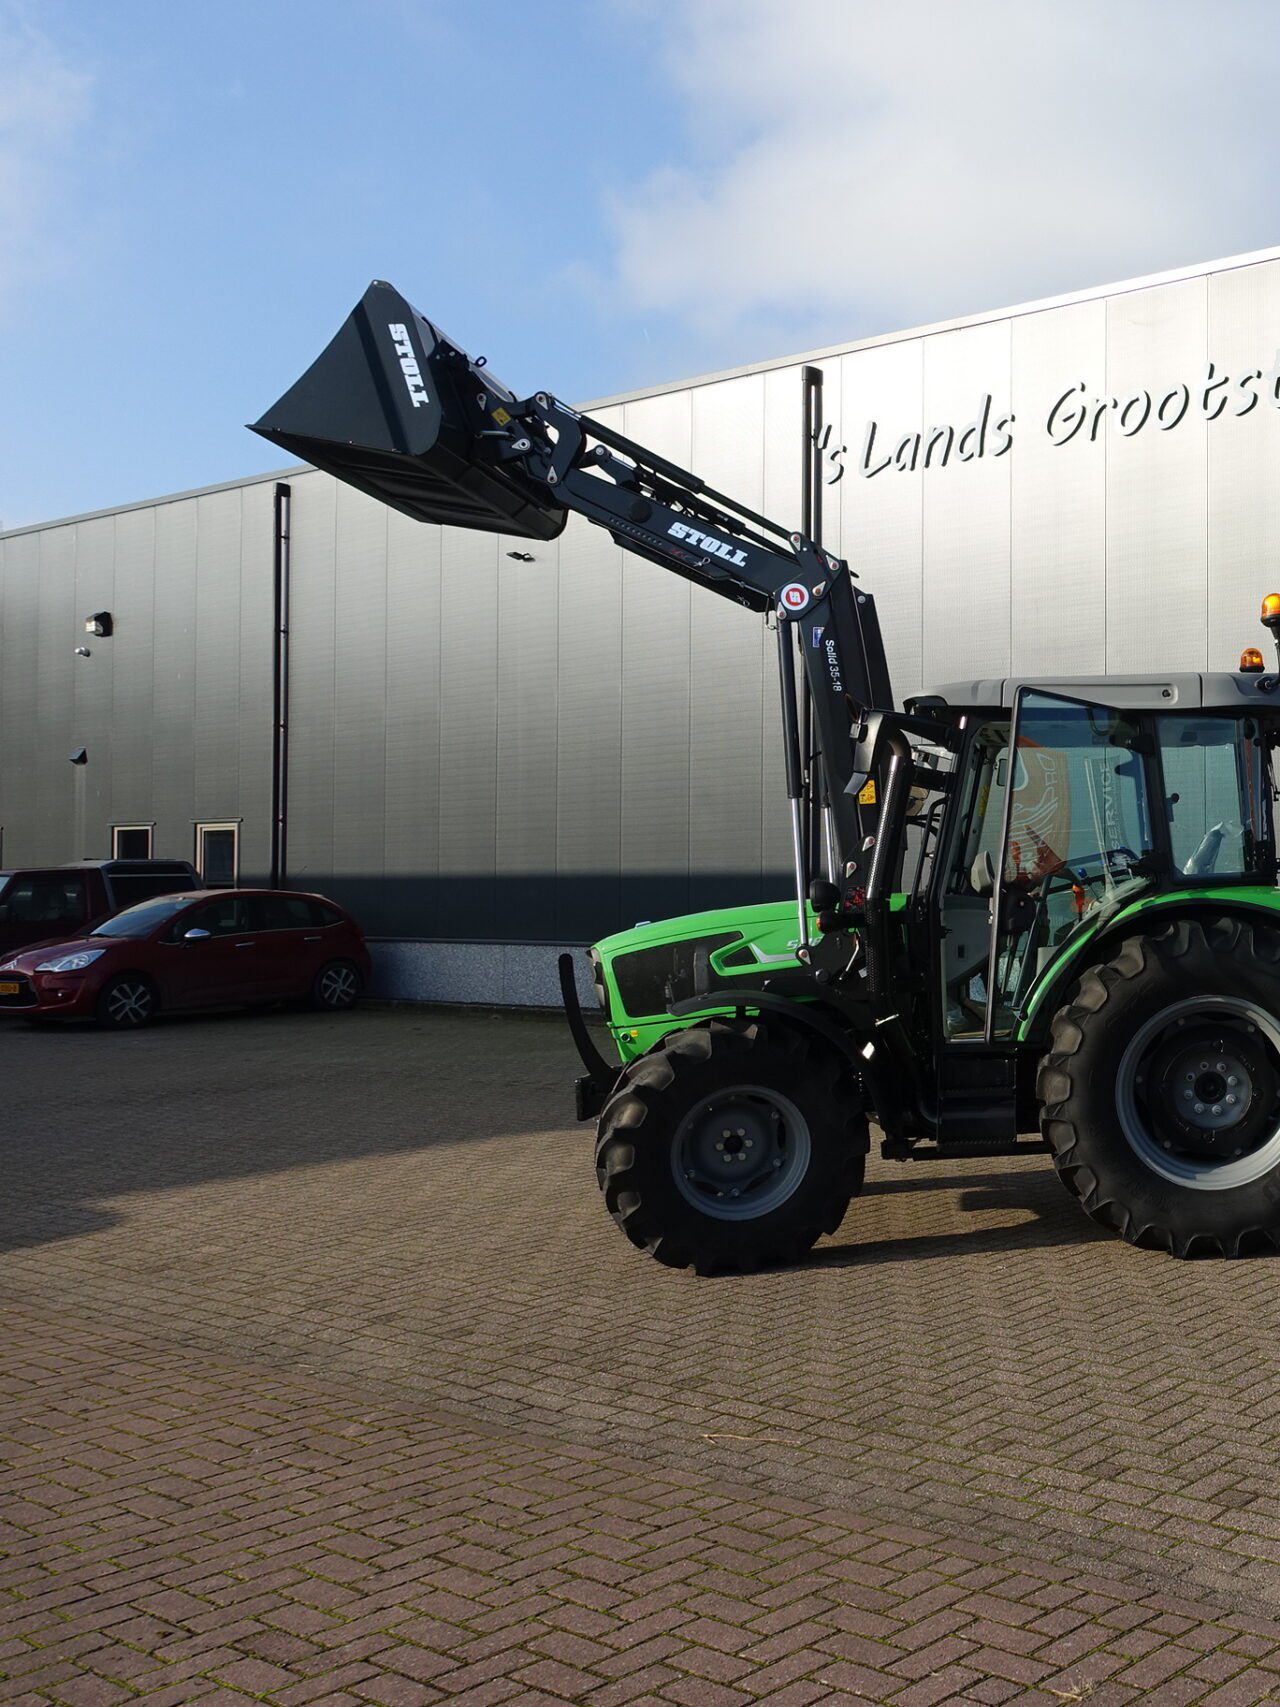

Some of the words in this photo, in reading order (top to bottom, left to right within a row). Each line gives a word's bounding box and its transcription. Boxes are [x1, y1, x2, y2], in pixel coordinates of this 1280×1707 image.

[388, 323, 429, 407] STOLL
[859, 393, 1015, 478] Lands
[667, 521, 748, 567] STOLL
[825, 640, 838, 665] Solid
[829, 665, 842, 692] 35-18
[1100, 763, 1120, 849] SERVICE
